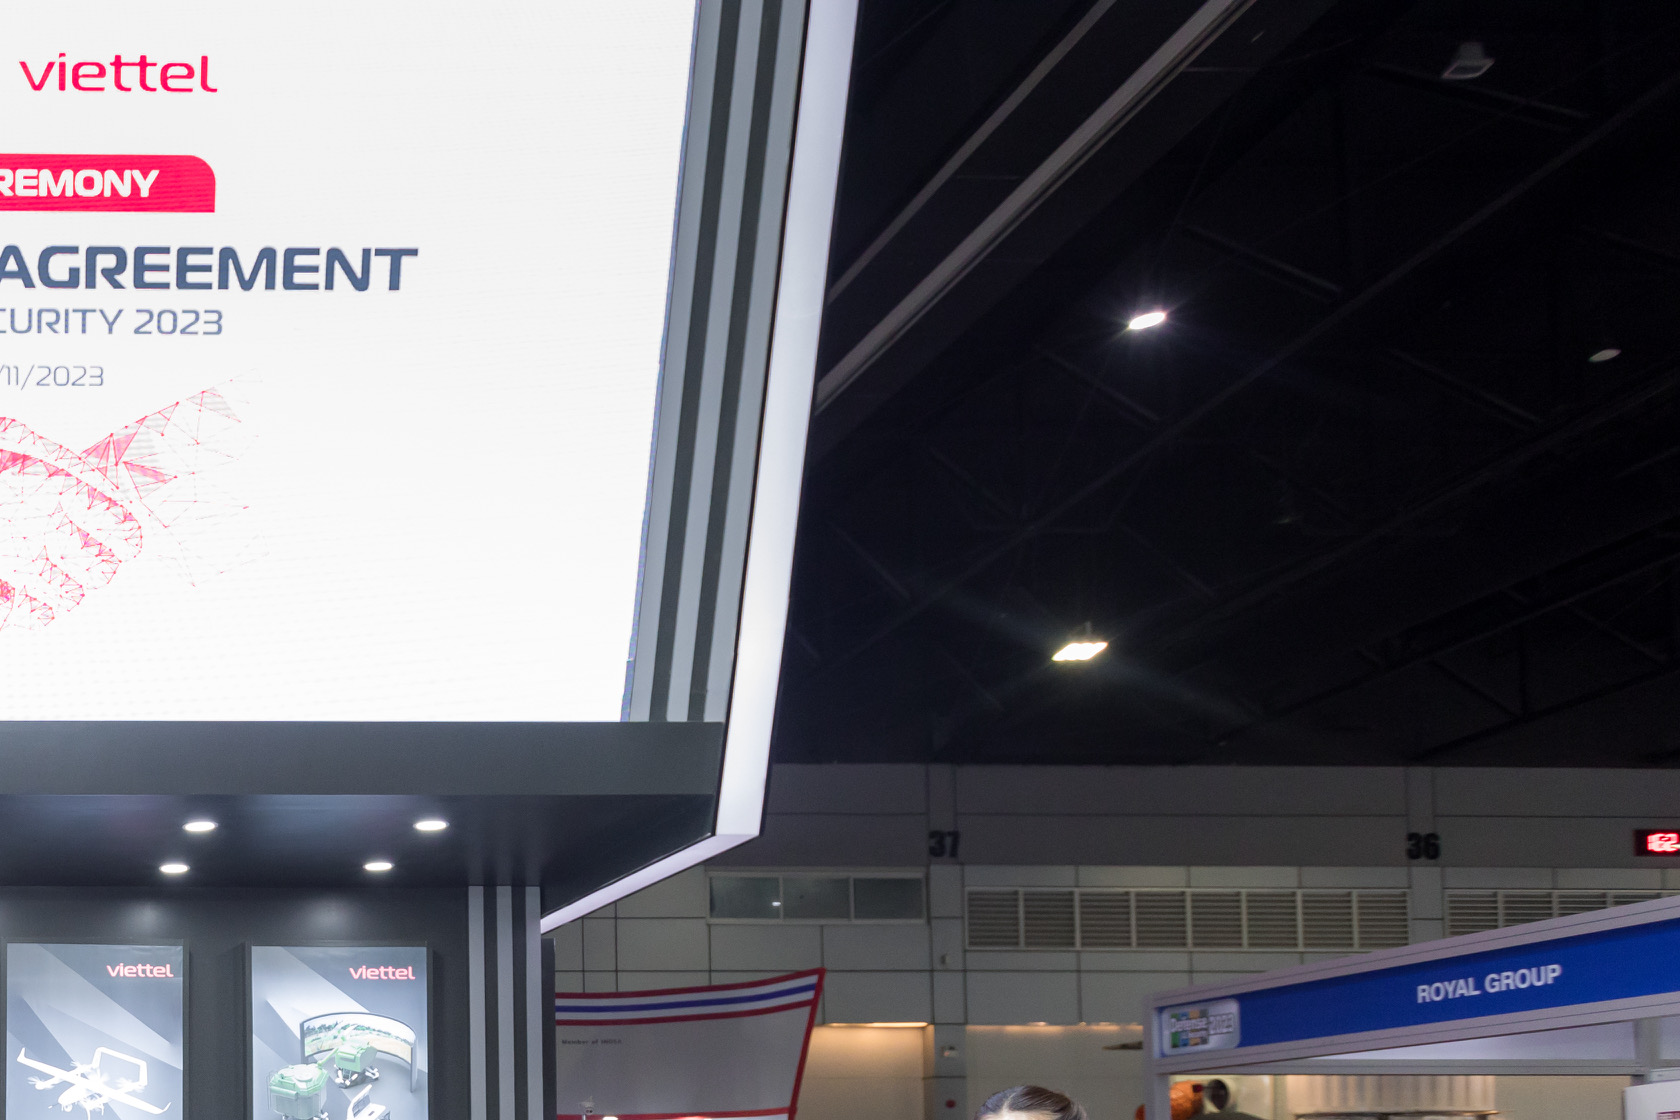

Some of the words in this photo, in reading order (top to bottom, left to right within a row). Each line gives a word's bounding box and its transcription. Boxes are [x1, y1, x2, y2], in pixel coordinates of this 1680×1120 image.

[19, 52, 218, 94] viettel
[134, 308, 223, 335] 2023
[928, 830, 961, 858] 37
[1406, 831, 1441, 861] 36
[106, 962, 174, 979] viettel
[349, 965, 416, 981] viettel
[1416, 976, 1480, 1004] ROYAL
[1484, 964, 1562, 995] GROUP
